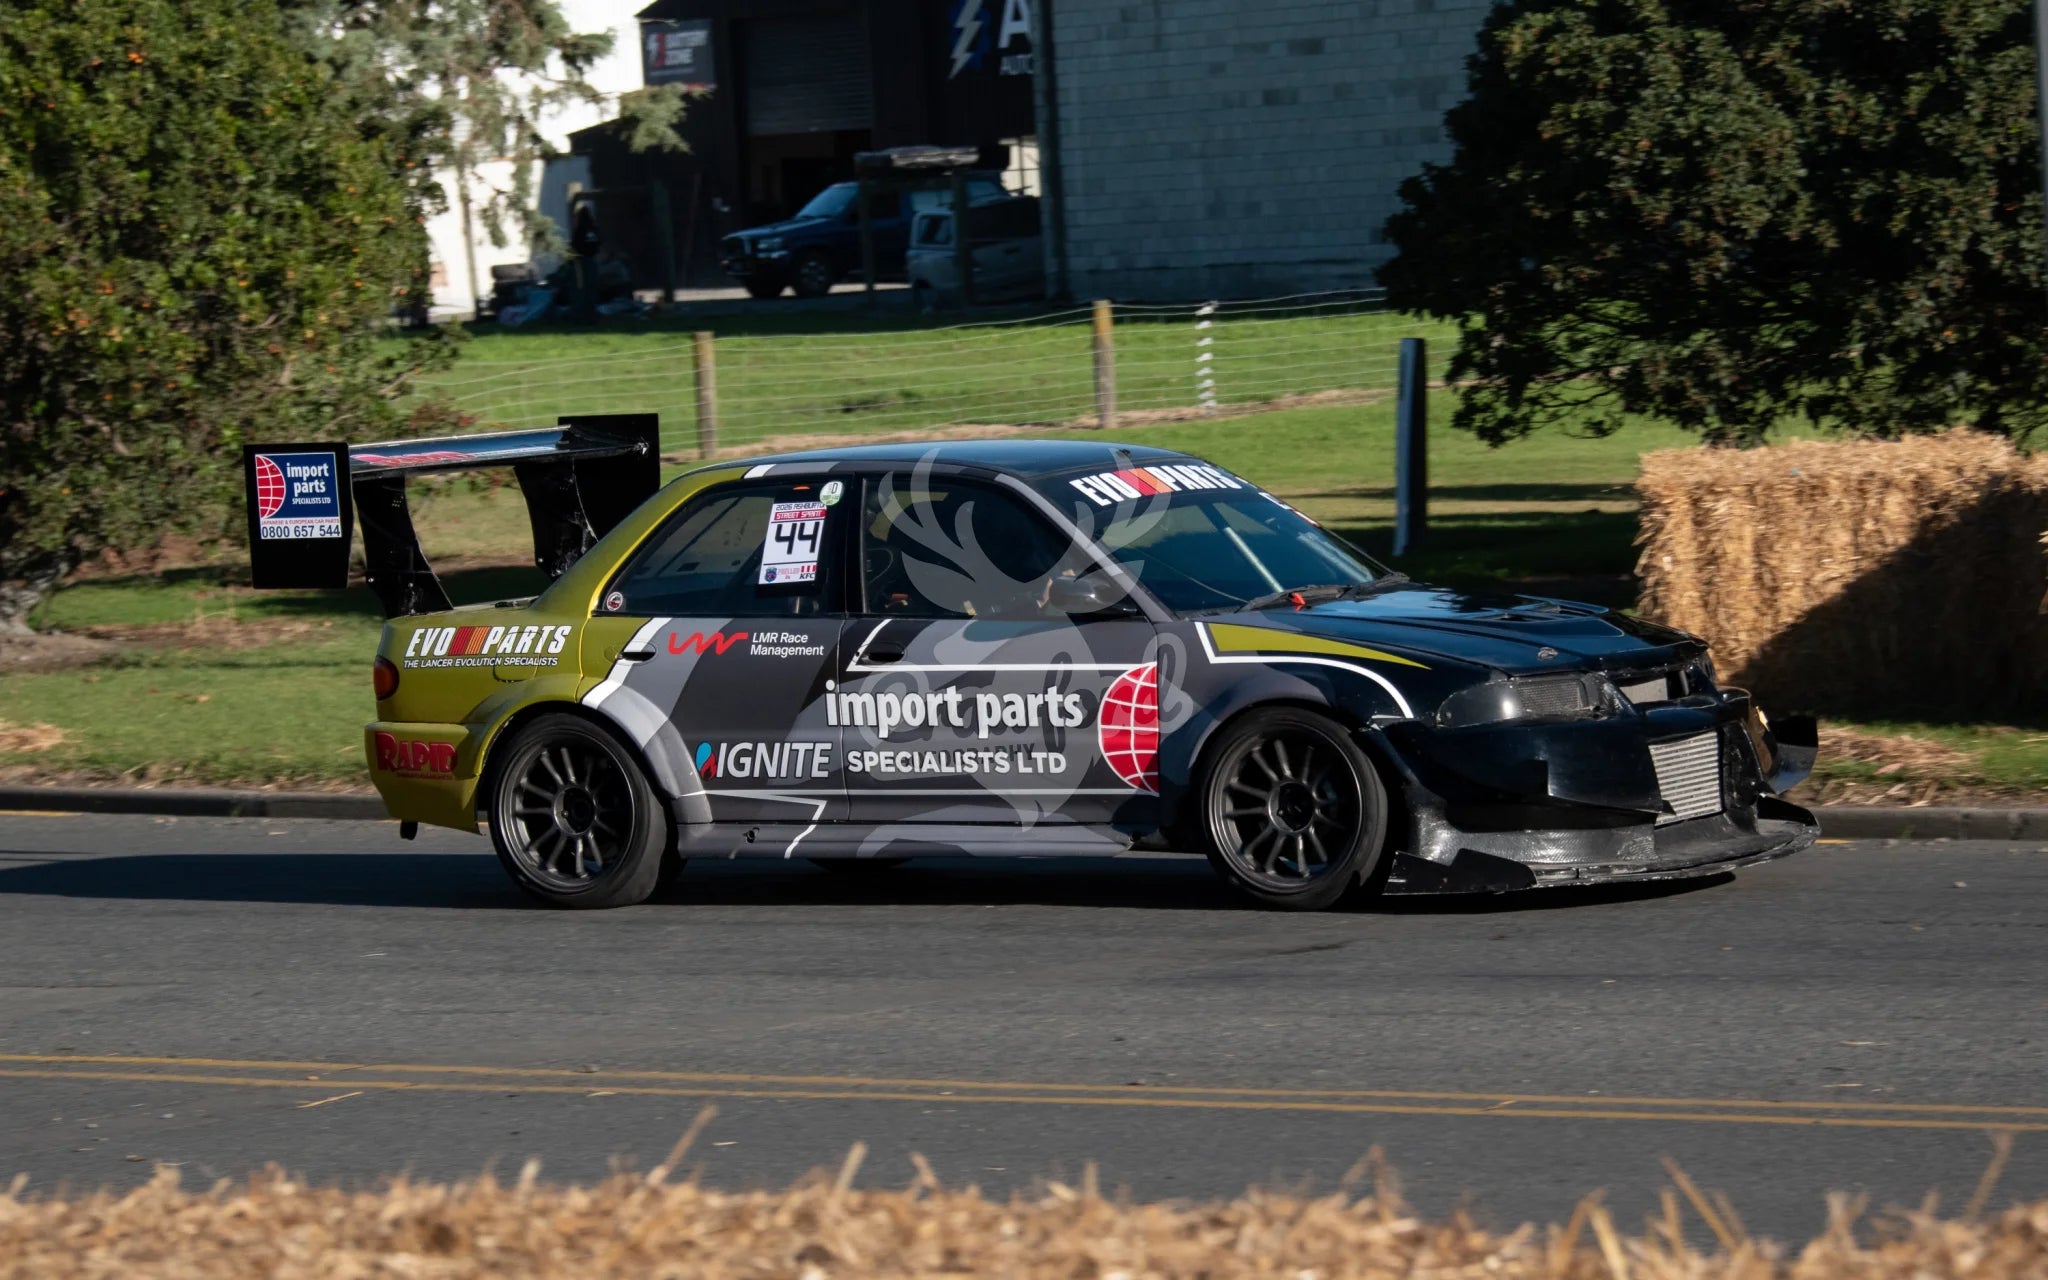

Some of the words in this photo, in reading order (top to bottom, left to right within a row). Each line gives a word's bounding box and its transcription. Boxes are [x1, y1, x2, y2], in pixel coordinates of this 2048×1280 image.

[286, 462, 329, 481] import
[293, 479, 326, 497] parts
[1069, 472, 1142, 507] EVO
[1143, 465, 1243, 492] PARTS
[292, 497, 322, 505] SPECIALISTS
[261, 525, 290, 538] 0800
[293, 525, 315, 537] 657
[319, 524, 341, 537] 544
[775, 521, 820, 555] 44
[798, 572, 815, 580] KFC
[405, 627, 456, 658] EVO
[481, 625, 572, 655] PARTS
[752, 632, 778, 643] LMR
[779, 632, 808, 643] Race
[750, 644, 825, 658] Management
[403, 660, 419, 668] THE
[420, 658, 453, 668] LANCER
[454, 657, 501, 667] EVOLUTION
[503, 656, 559, 666] SPECIALISTS
[825, 679, 965, 739] import
[978, 685, 1084, 739] parts
[716, 741, 833, 779] IGNITE
[847, 749, 1013, 775] SPECIALISTS
[1017, 751, 1067, 774] LTD
